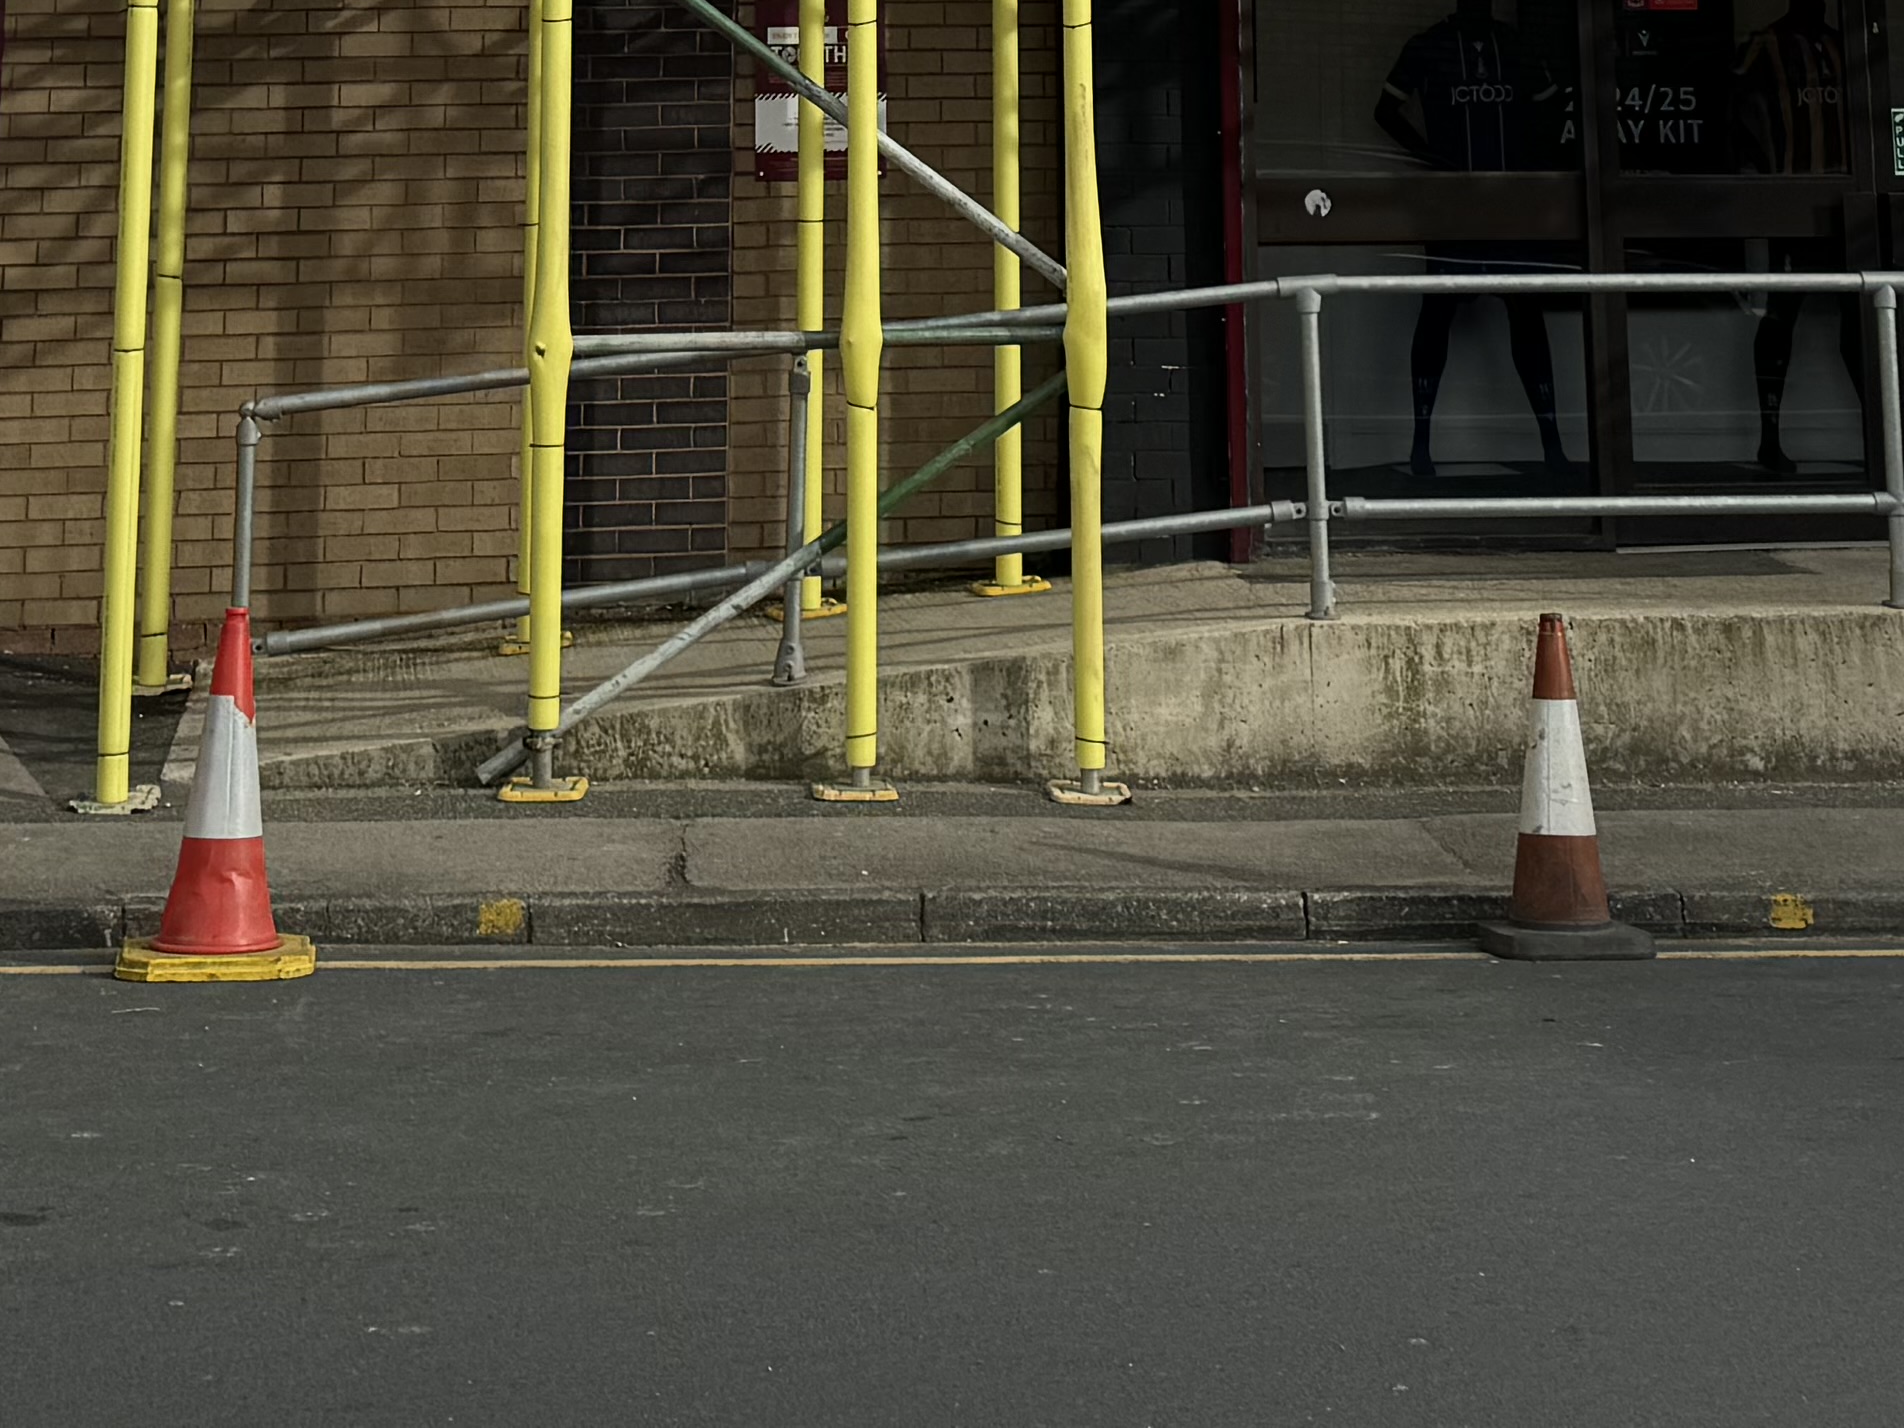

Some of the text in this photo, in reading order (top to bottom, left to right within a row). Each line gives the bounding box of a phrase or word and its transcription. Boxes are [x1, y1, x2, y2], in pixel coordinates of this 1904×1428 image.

[1563, 83, 1696, 113] 24/25
[1559, 119, 1705, 144] AAY KIT
[1896, 125, 1904, 169] PULL
